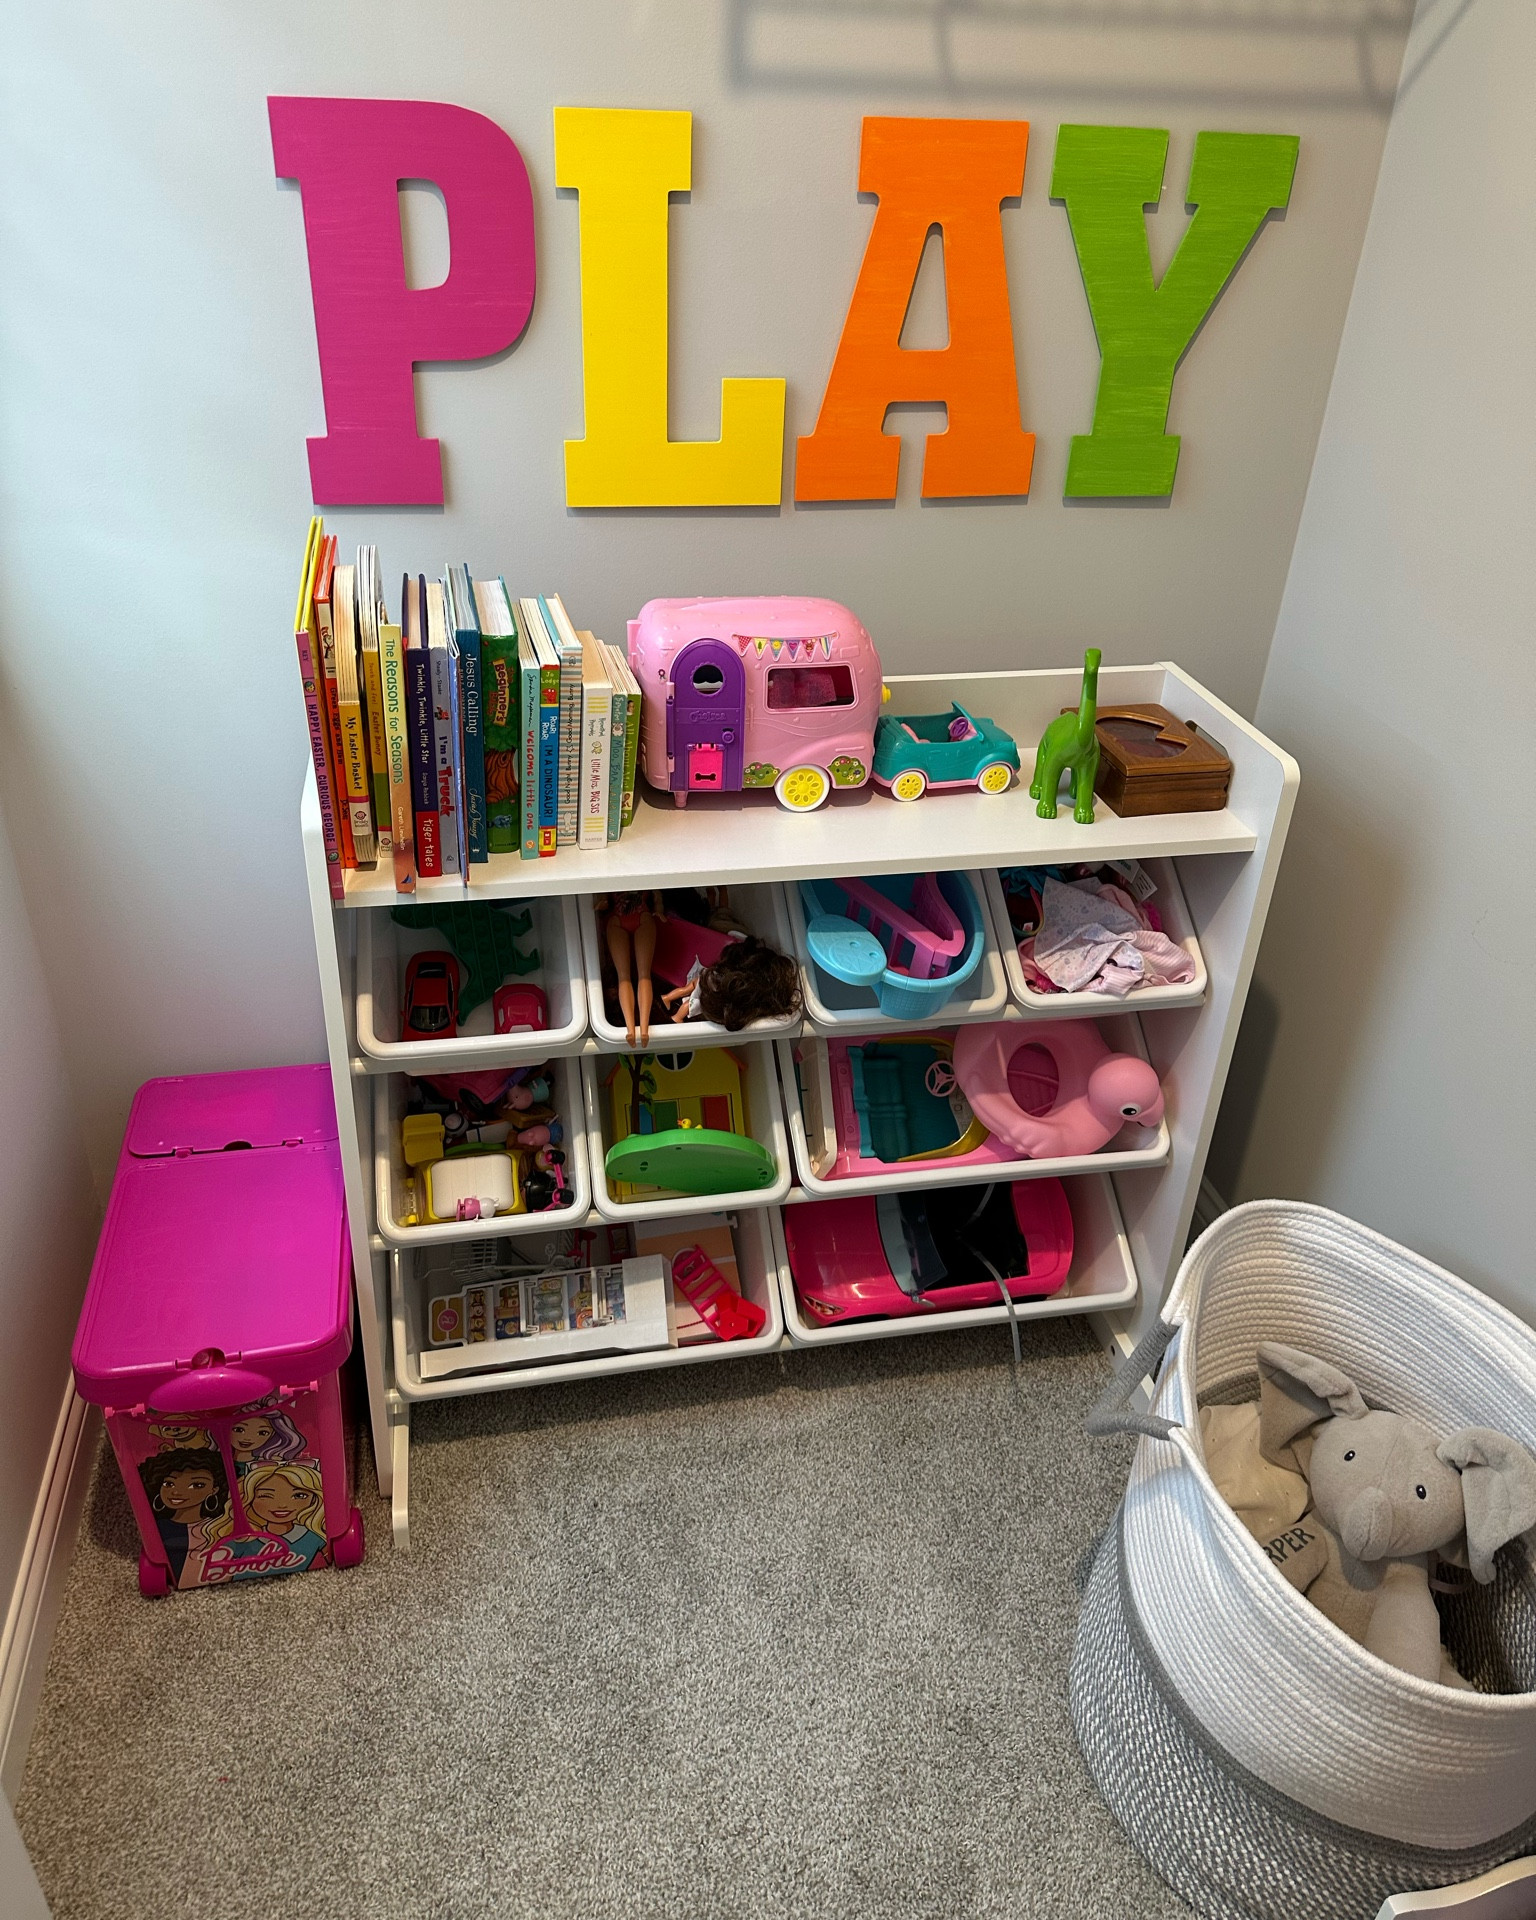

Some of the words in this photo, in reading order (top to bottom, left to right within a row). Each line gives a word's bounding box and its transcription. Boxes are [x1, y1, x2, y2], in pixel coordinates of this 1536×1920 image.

[268, 95, 1300, 508] PLAY
[385, 639, 395, 657] The
[416, 663, 426, 694] Twinkle,
[466, 654, 478, 688] Jesus
[541, 677, 559, 685] Lodge
[385, 660, 399, 713] Reasons
[495, 663, 508, 722] Beginner's
[308, 703, 320, 733] HAPPY
[372, 711, 381, 733] Easter
[418, 697, 428, 727] Twinkle,
[613, 697, 624, 721] Boynton
[345, 717, 356, 729] My
[390, 717, 400, 731] for
[541, 722, 550, 741] ROAR!
[549, 716, 558, 734] ROAR!
[626, 720, 634, 735] All
[349, 733, 359, 760] Easter
[374, 736, 382, 757] Bunny
[420, 729, 429, 747] Little
[439, 736, 448, 754] I'm
[312, 737, 325, 771] EASTER,
[391, 735, 404, 784] Seasons
[420, 750, 429, 764] Star
[526, 730, 535, 777] welcome
[591, 758, 601, 773] Little
[625, 740, 633, 767] About
[351, 762, 362, 789] Basket
[318, 775, 331, 810] CURIOUS
[438, 766, 455, 817] Truck
[469, 788, 482, 813] Sarah
[527, 780, 535, 808] little
[544, 769, 553, 818] DINOSAUR!
[564, 789, 572, 804] Good
[590, 791, 600, 802] BIG
[590, 803, 600, 814] SIS
[324, 813, 335, 843] GEORGE
[423, 819, 434, 842] tiger
[469, 813, 484, 840] Young
[424, 845, 435, 867] tales
[198, 1540, 306, 1583] Barbie
